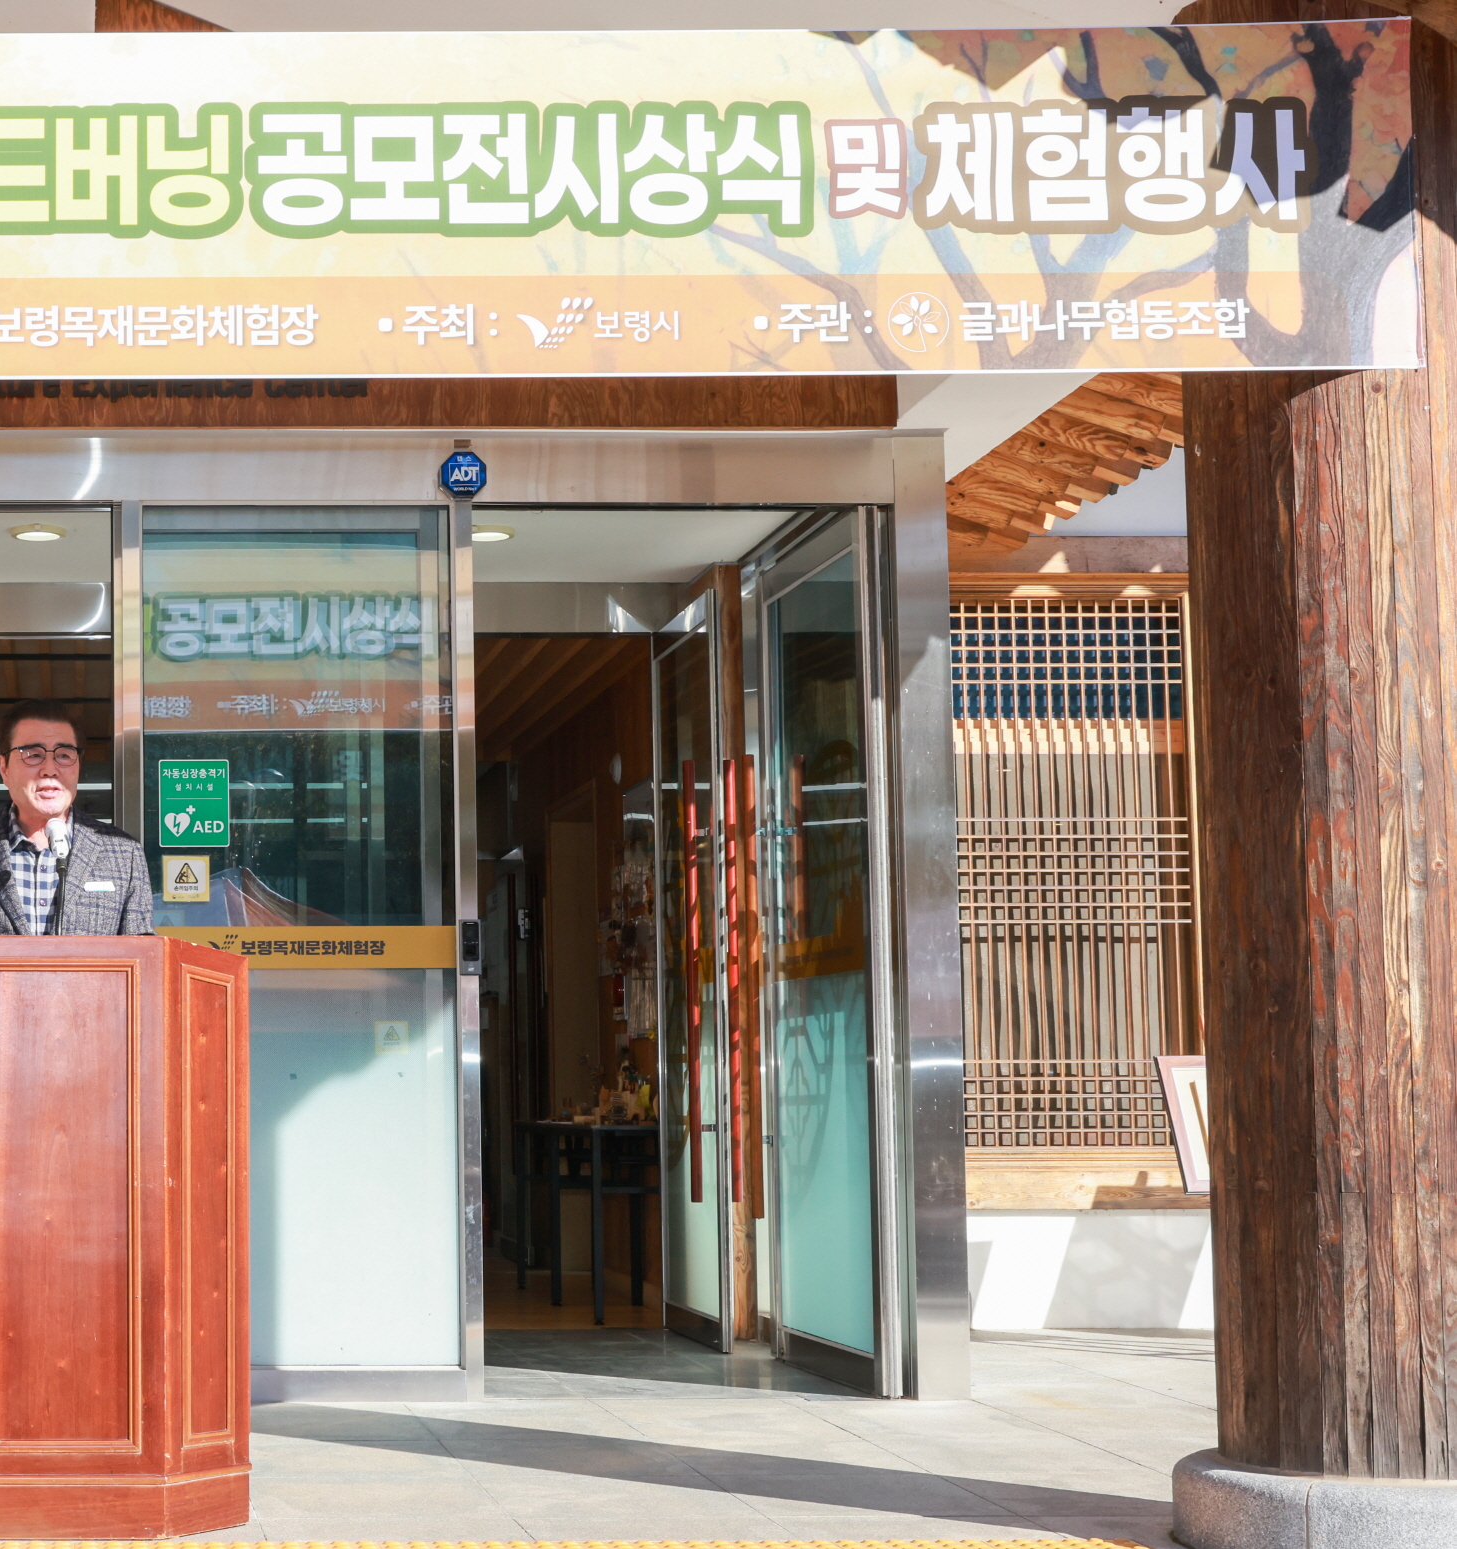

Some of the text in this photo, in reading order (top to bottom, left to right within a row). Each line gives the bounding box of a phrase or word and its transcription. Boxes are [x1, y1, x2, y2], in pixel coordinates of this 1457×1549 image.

[833, 121, 902, 216] 및
[925, 106, 1307, 223] 체험행사
[402, 304, 476, 347] 주최
[593, 310, 681, 343] 보령시
[777, 301, 852, 343] 주관
[958, 298, 1251, 341] 글과나무협동조합
[450, 466, 479, 481] ADT
[162, 768, 226, 779] 자동심장충격기
[192, 820, 224, 833] AED
[240, 940, 386, 956] 보령목재문화체험장
